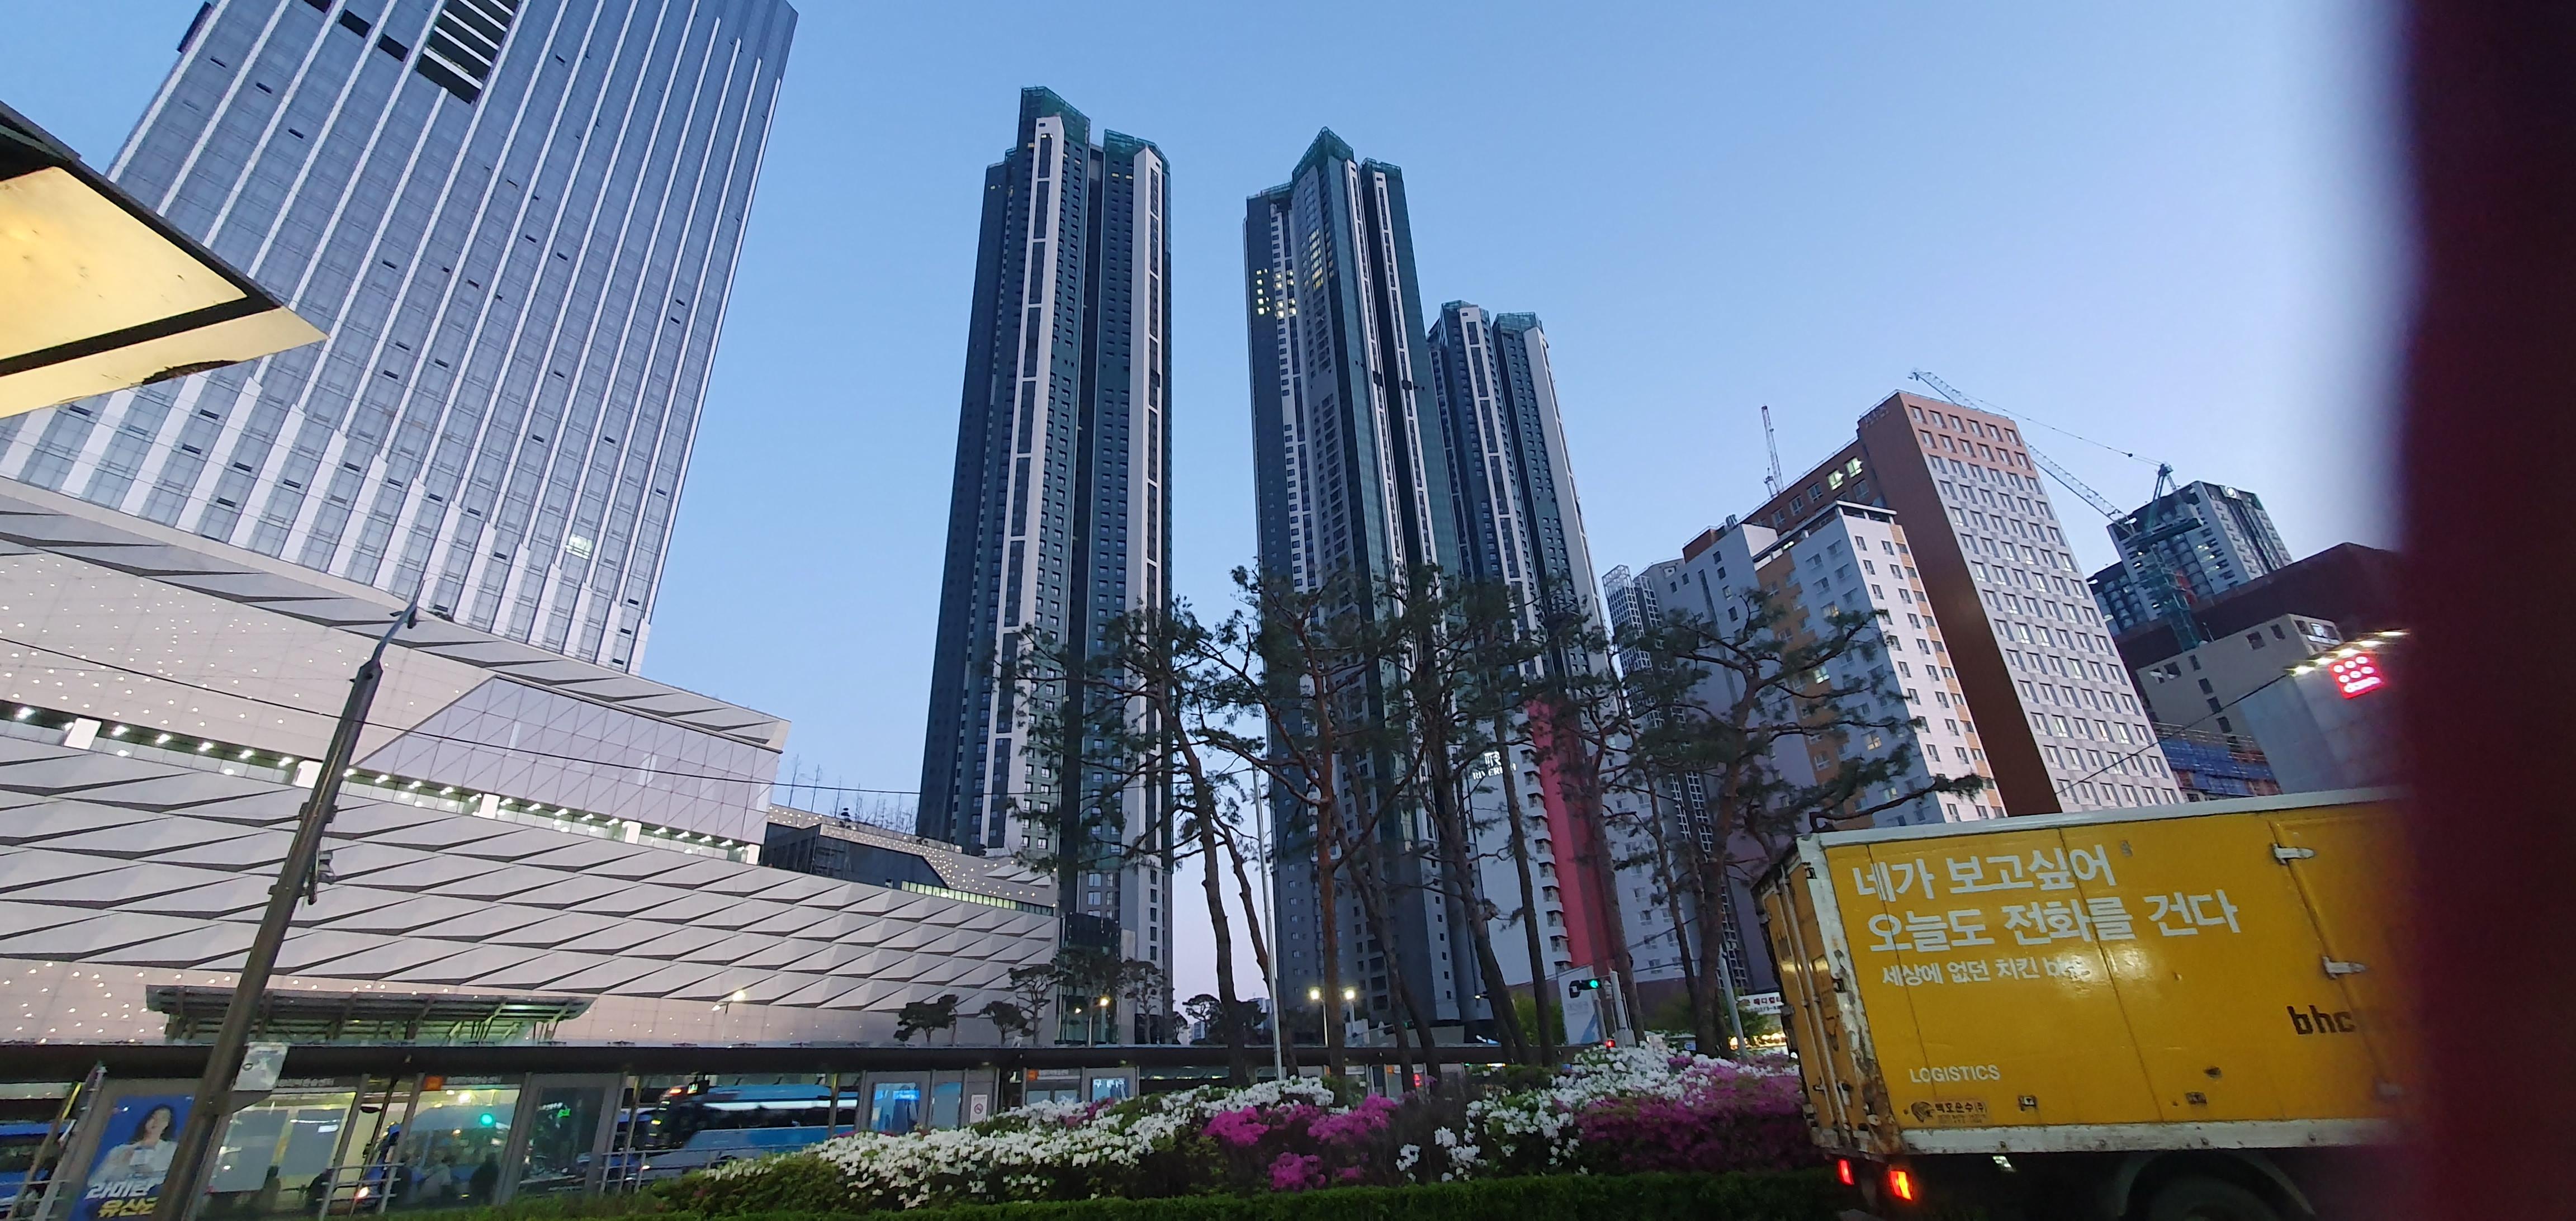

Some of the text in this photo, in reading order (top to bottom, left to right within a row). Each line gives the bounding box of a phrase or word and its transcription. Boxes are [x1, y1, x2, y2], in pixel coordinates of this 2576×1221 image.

[1472, 763, 1517, 780] RIVERI
[1853, 844, 2117, 902] 네가 보고싶어
[1868, 889, 2241, 952] 오늘도 전화를 건다
[1882, 962, 1943, 986] 세상에
[1946, 959, 1991, 982] 없던
[1995, 957, 2040, 980] 치킨
[2286, 1005, 2356, 1035] bhc
[1909, 1064, 2001, 1083] LOGISTICS
